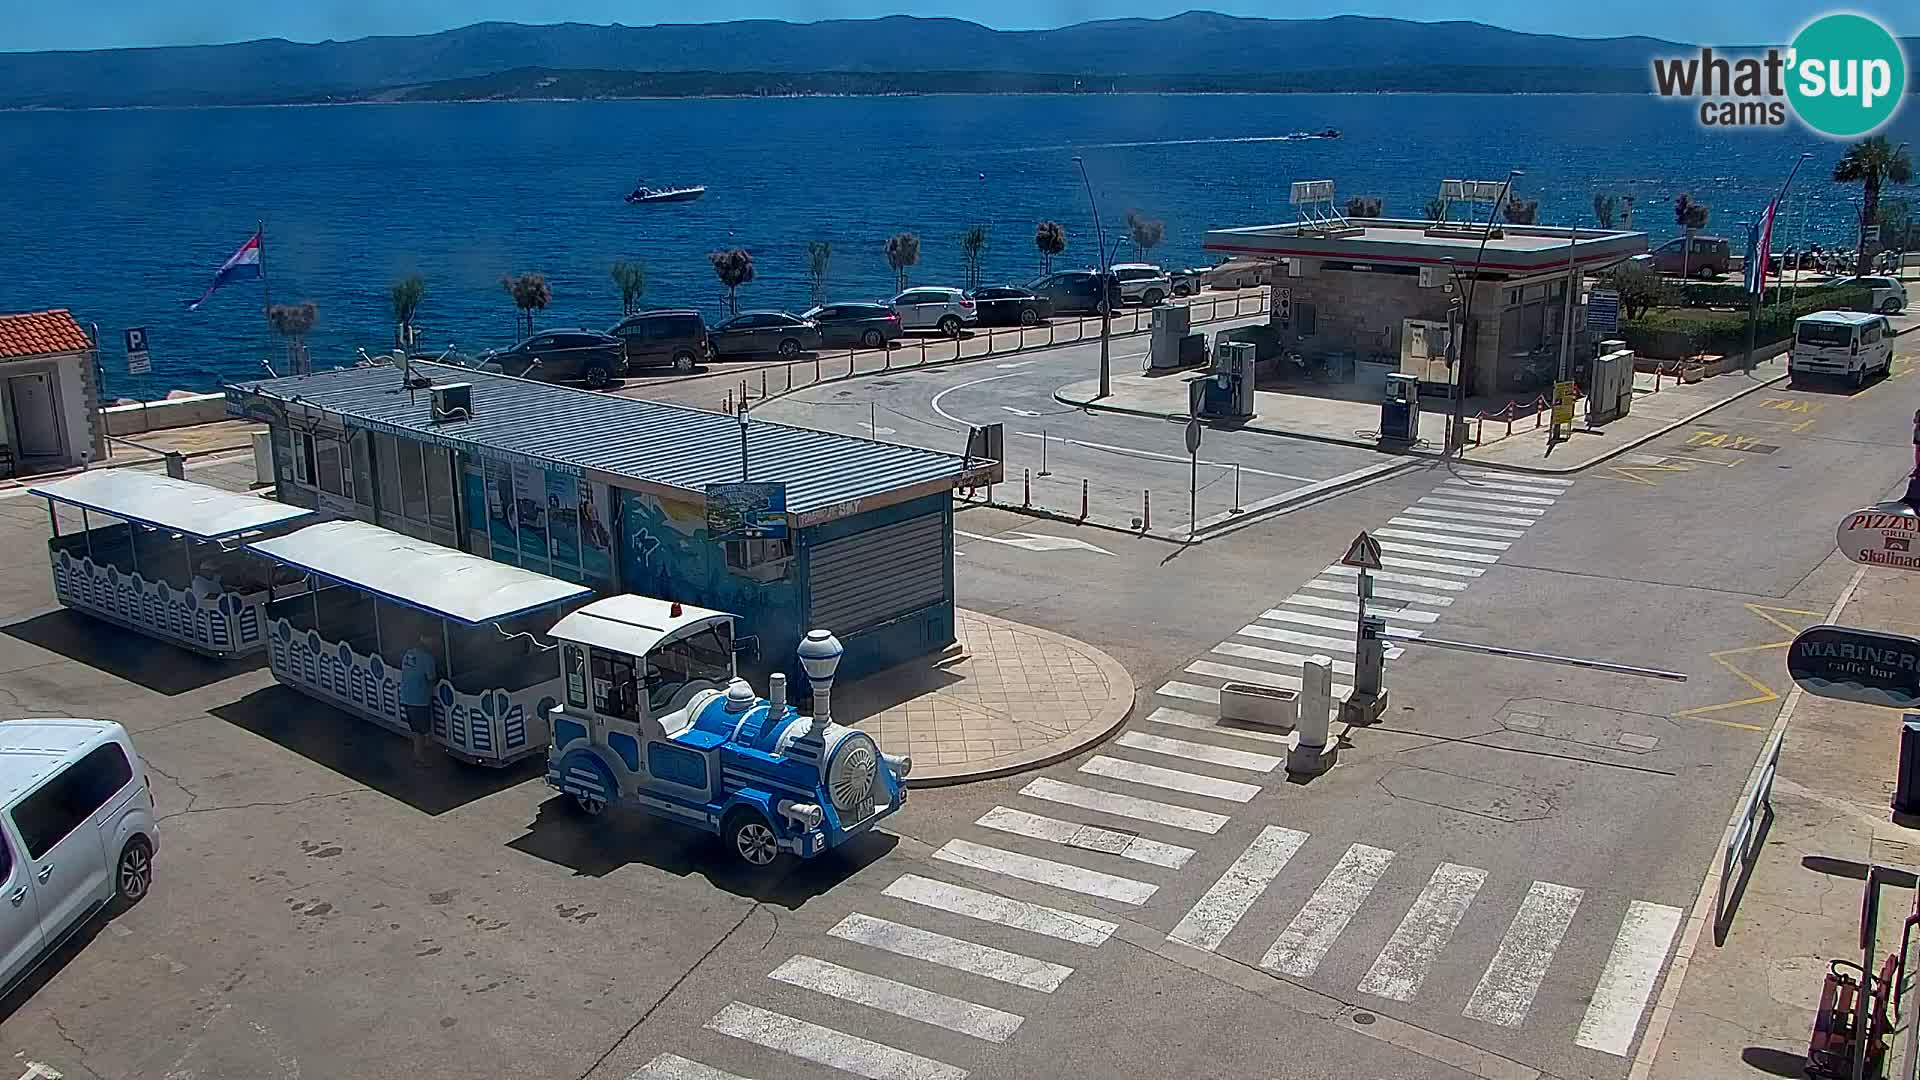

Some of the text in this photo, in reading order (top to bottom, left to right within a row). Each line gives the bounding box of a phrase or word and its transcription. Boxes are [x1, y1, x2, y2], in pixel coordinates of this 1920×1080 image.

[130, 331, 141, 348] P
[1685, 431, 1761, 450] TAXI
[527, 457, 553, 471] TICKET
[555, 462, 582, 476] OFFICE
[1800, 641, 1920, 672] MARINER
[1870, 664, 1896, 680] bar
